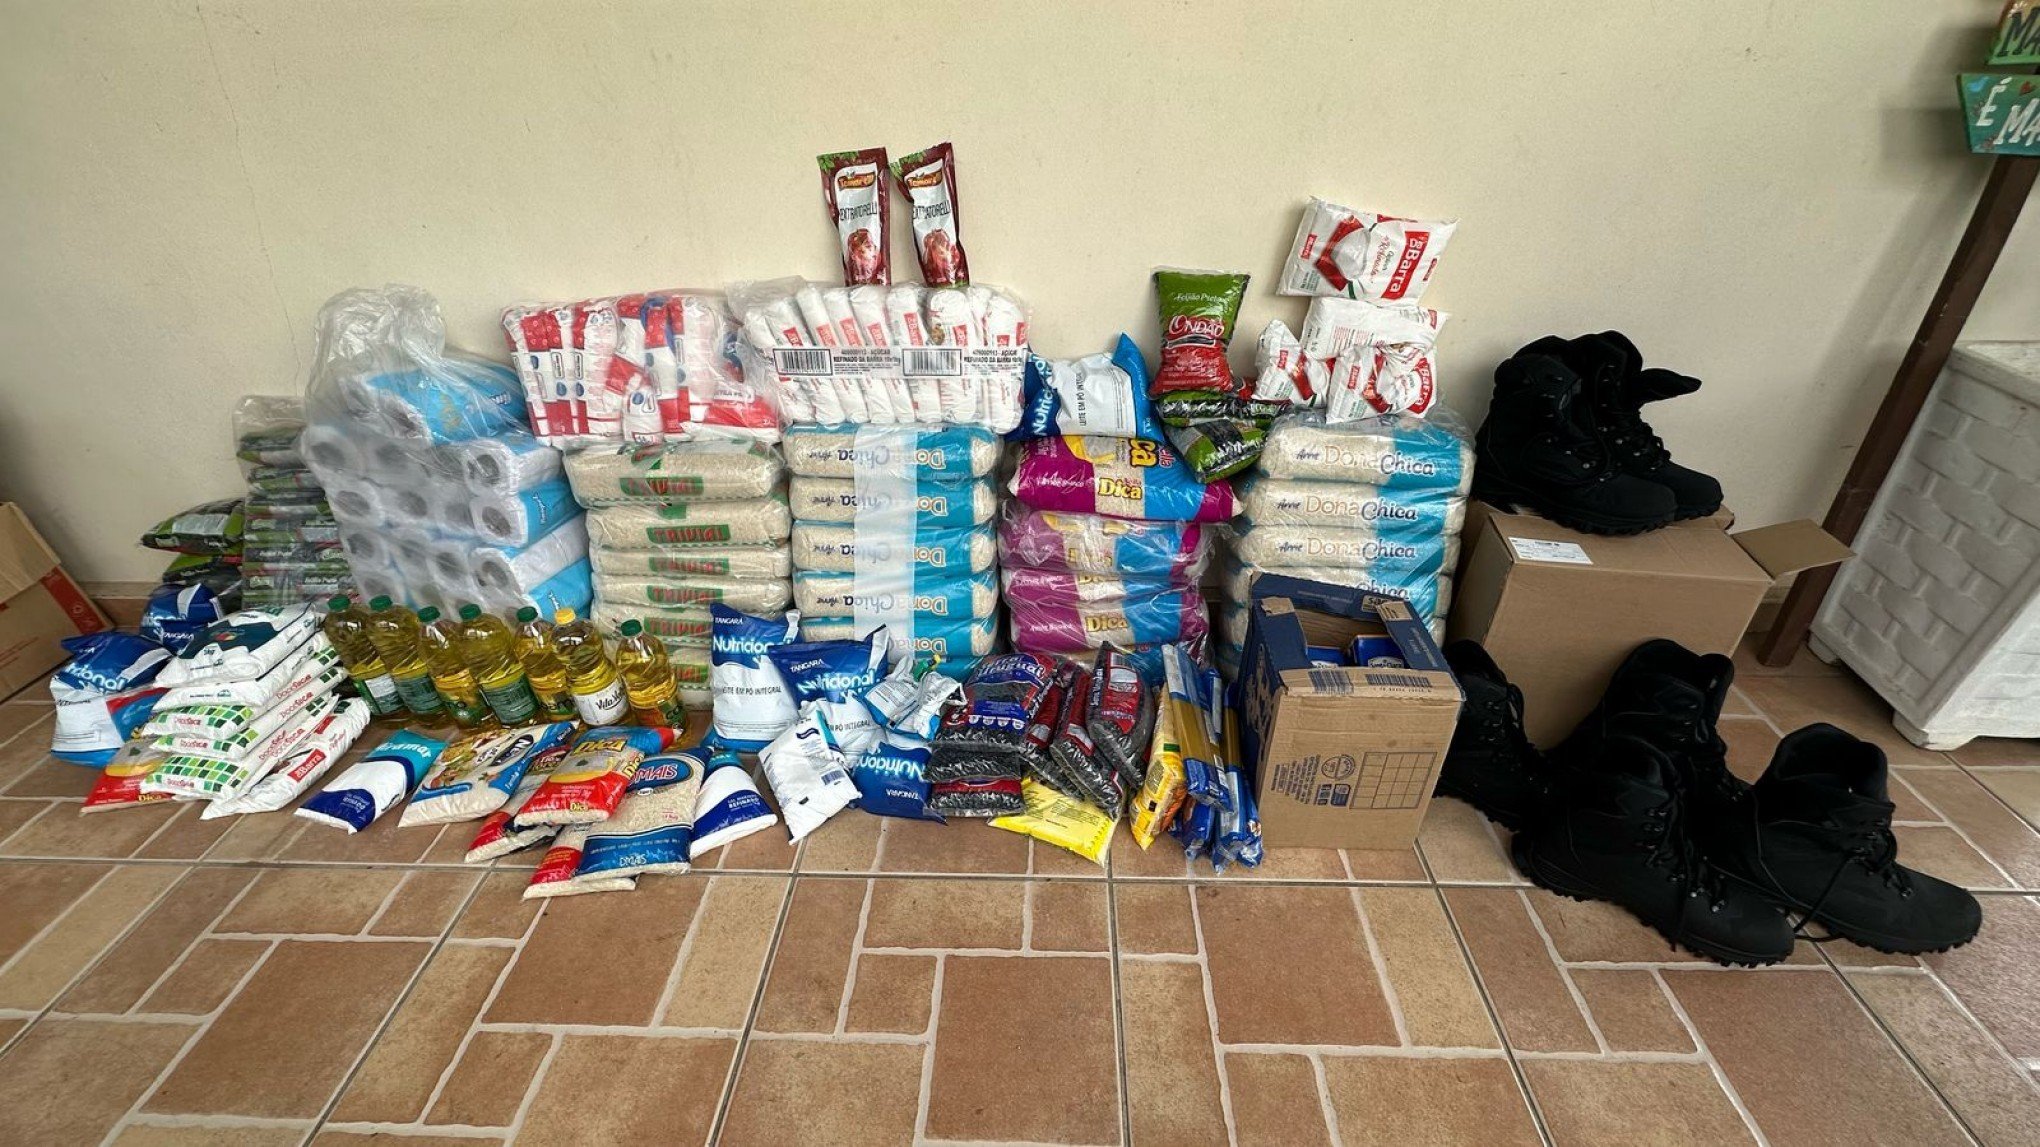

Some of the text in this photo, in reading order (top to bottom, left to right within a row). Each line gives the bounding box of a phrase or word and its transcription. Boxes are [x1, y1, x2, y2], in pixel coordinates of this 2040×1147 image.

[1976, 77, 2013, 126] É
[1390, 247, 1424, 294] Barra
[1129, 438, 1157, 468] ca
[1324, 445, 1380, 469] Dona
[1380, 451, 1435, 476] Chica
[1098, 477, 1142, 499] Dica
[1305, 494, 1361, 517] Dona
[1361, 497, 1419, 522] Chica
[1307, 537, 1361, 557] Dona
[1362, 538, 1416, 561] Chica
[1085, 616, 1128, 633] Dica
[634, 763, 678, 782] MAIS
[857, 754, 926, 780] Nutricion
